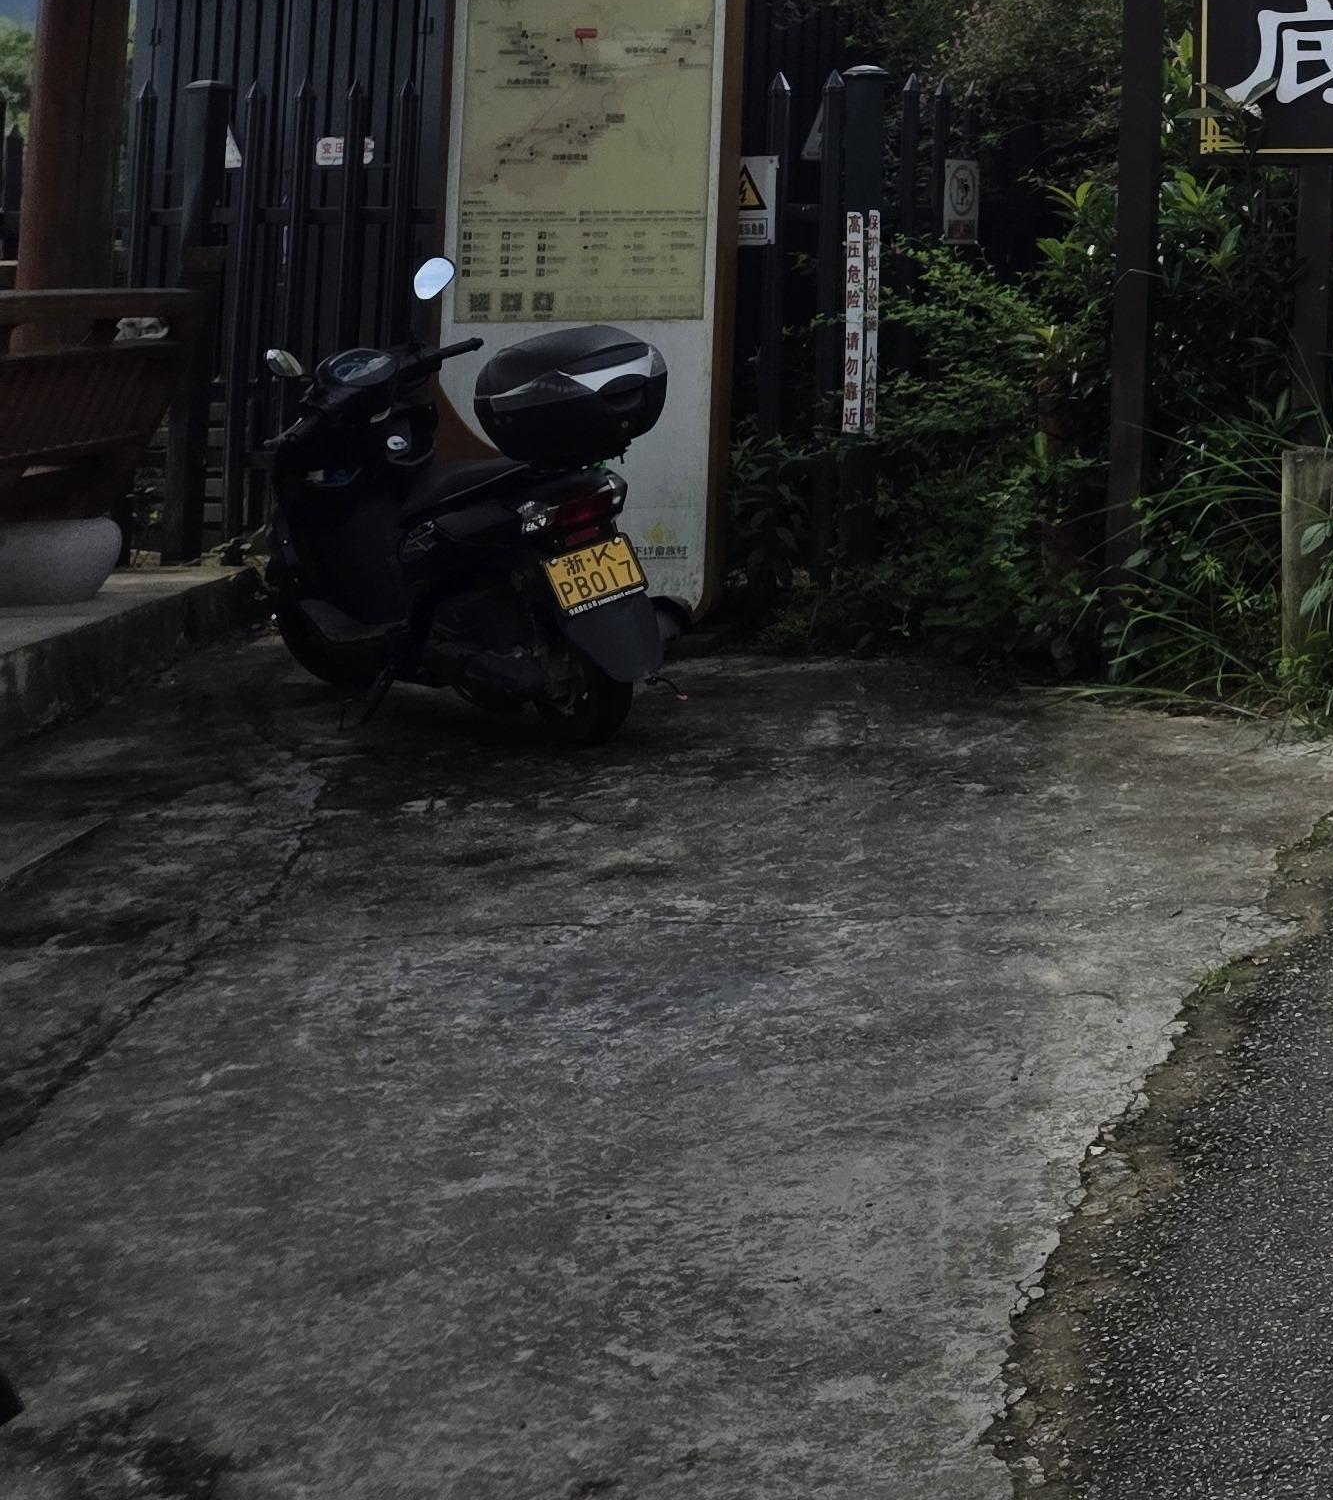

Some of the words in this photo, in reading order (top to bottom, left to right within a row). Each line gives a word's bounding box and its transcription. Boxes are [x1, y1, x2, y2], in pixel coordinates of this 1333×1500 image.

[847, 213, 862, 309] 高压危险
[844, 331, 860, 426] 请勿靠近
[558, 560, 635, 604] PB017
[561, 543, 617, 577] 浙·K
